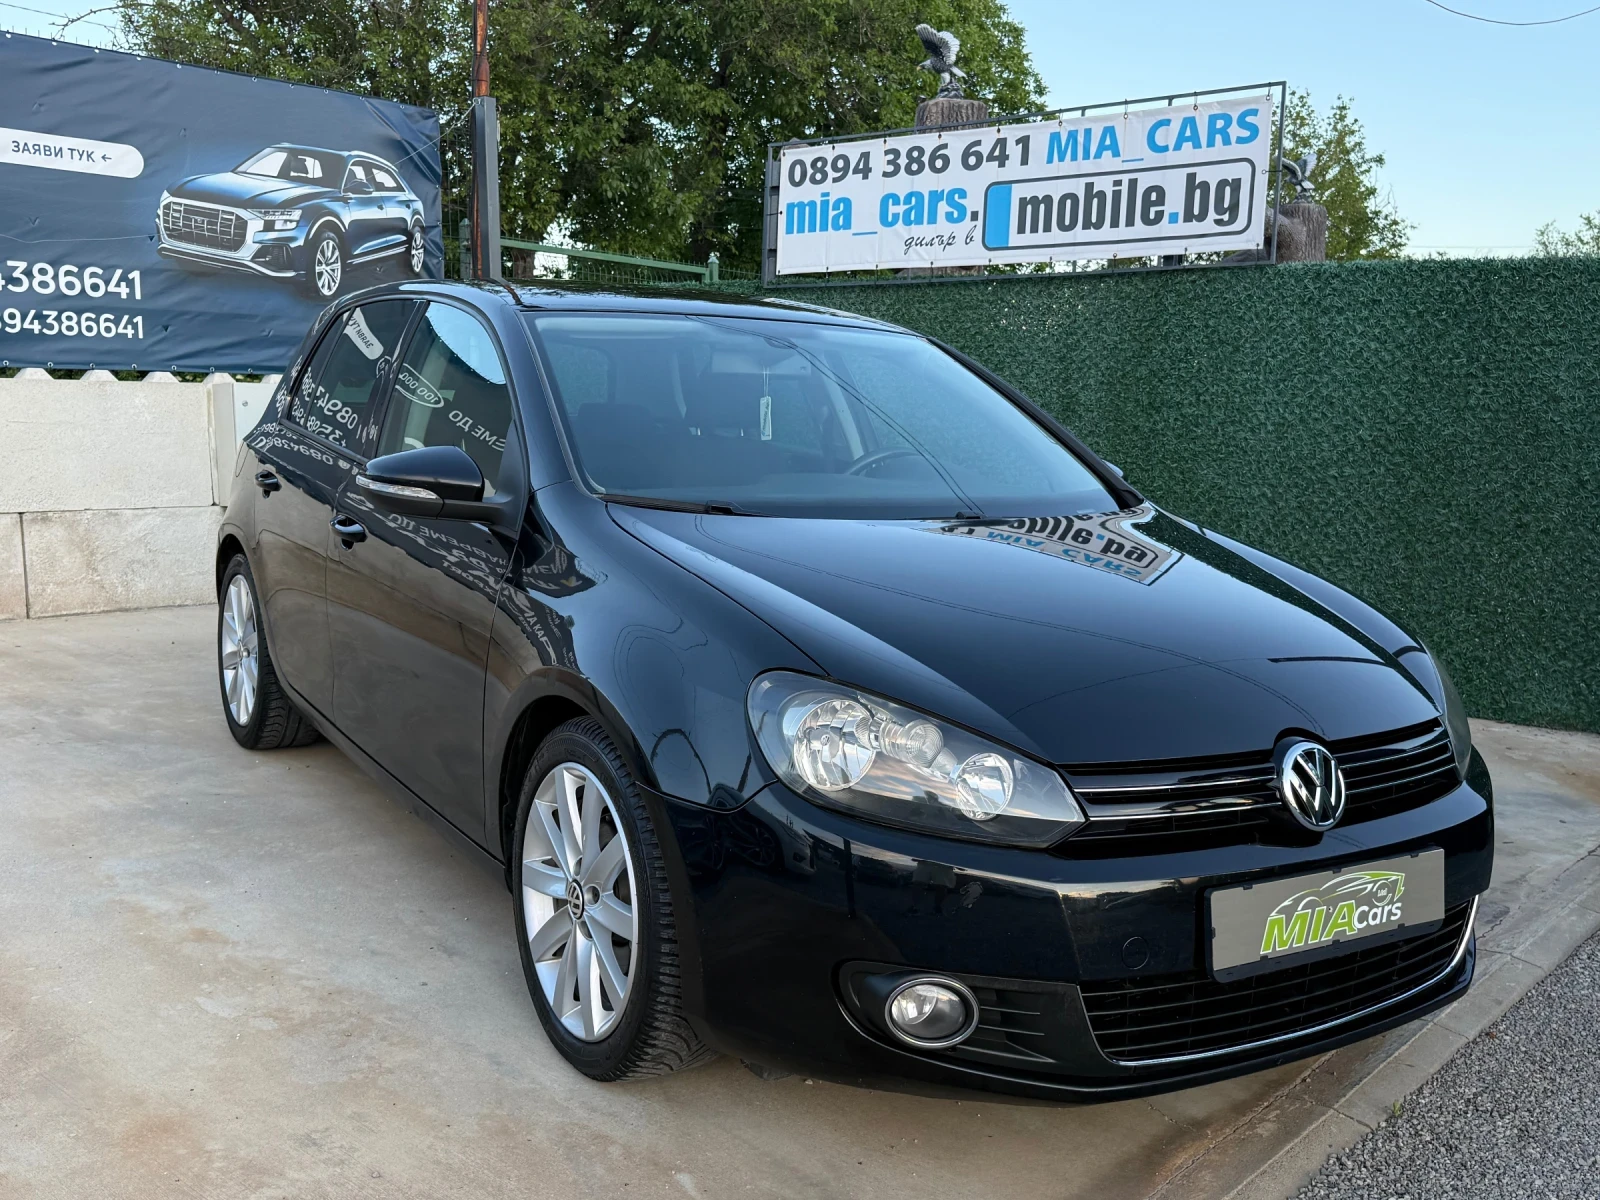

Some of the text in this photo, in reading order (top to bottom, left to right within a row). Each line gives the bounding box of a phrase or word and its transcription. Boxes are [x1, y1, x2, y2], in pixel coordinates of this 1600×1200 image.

[12, 140, 95, 163] ЗАЯВИ ТУК
[788, 151, 872, 187] 0894
[882, 143, 951, 178] 386
[961, 135, 1031, 171] 641
[1017, 172, 1242, 234] mobile.bg
[0, 307, 143, 339] 94386641
